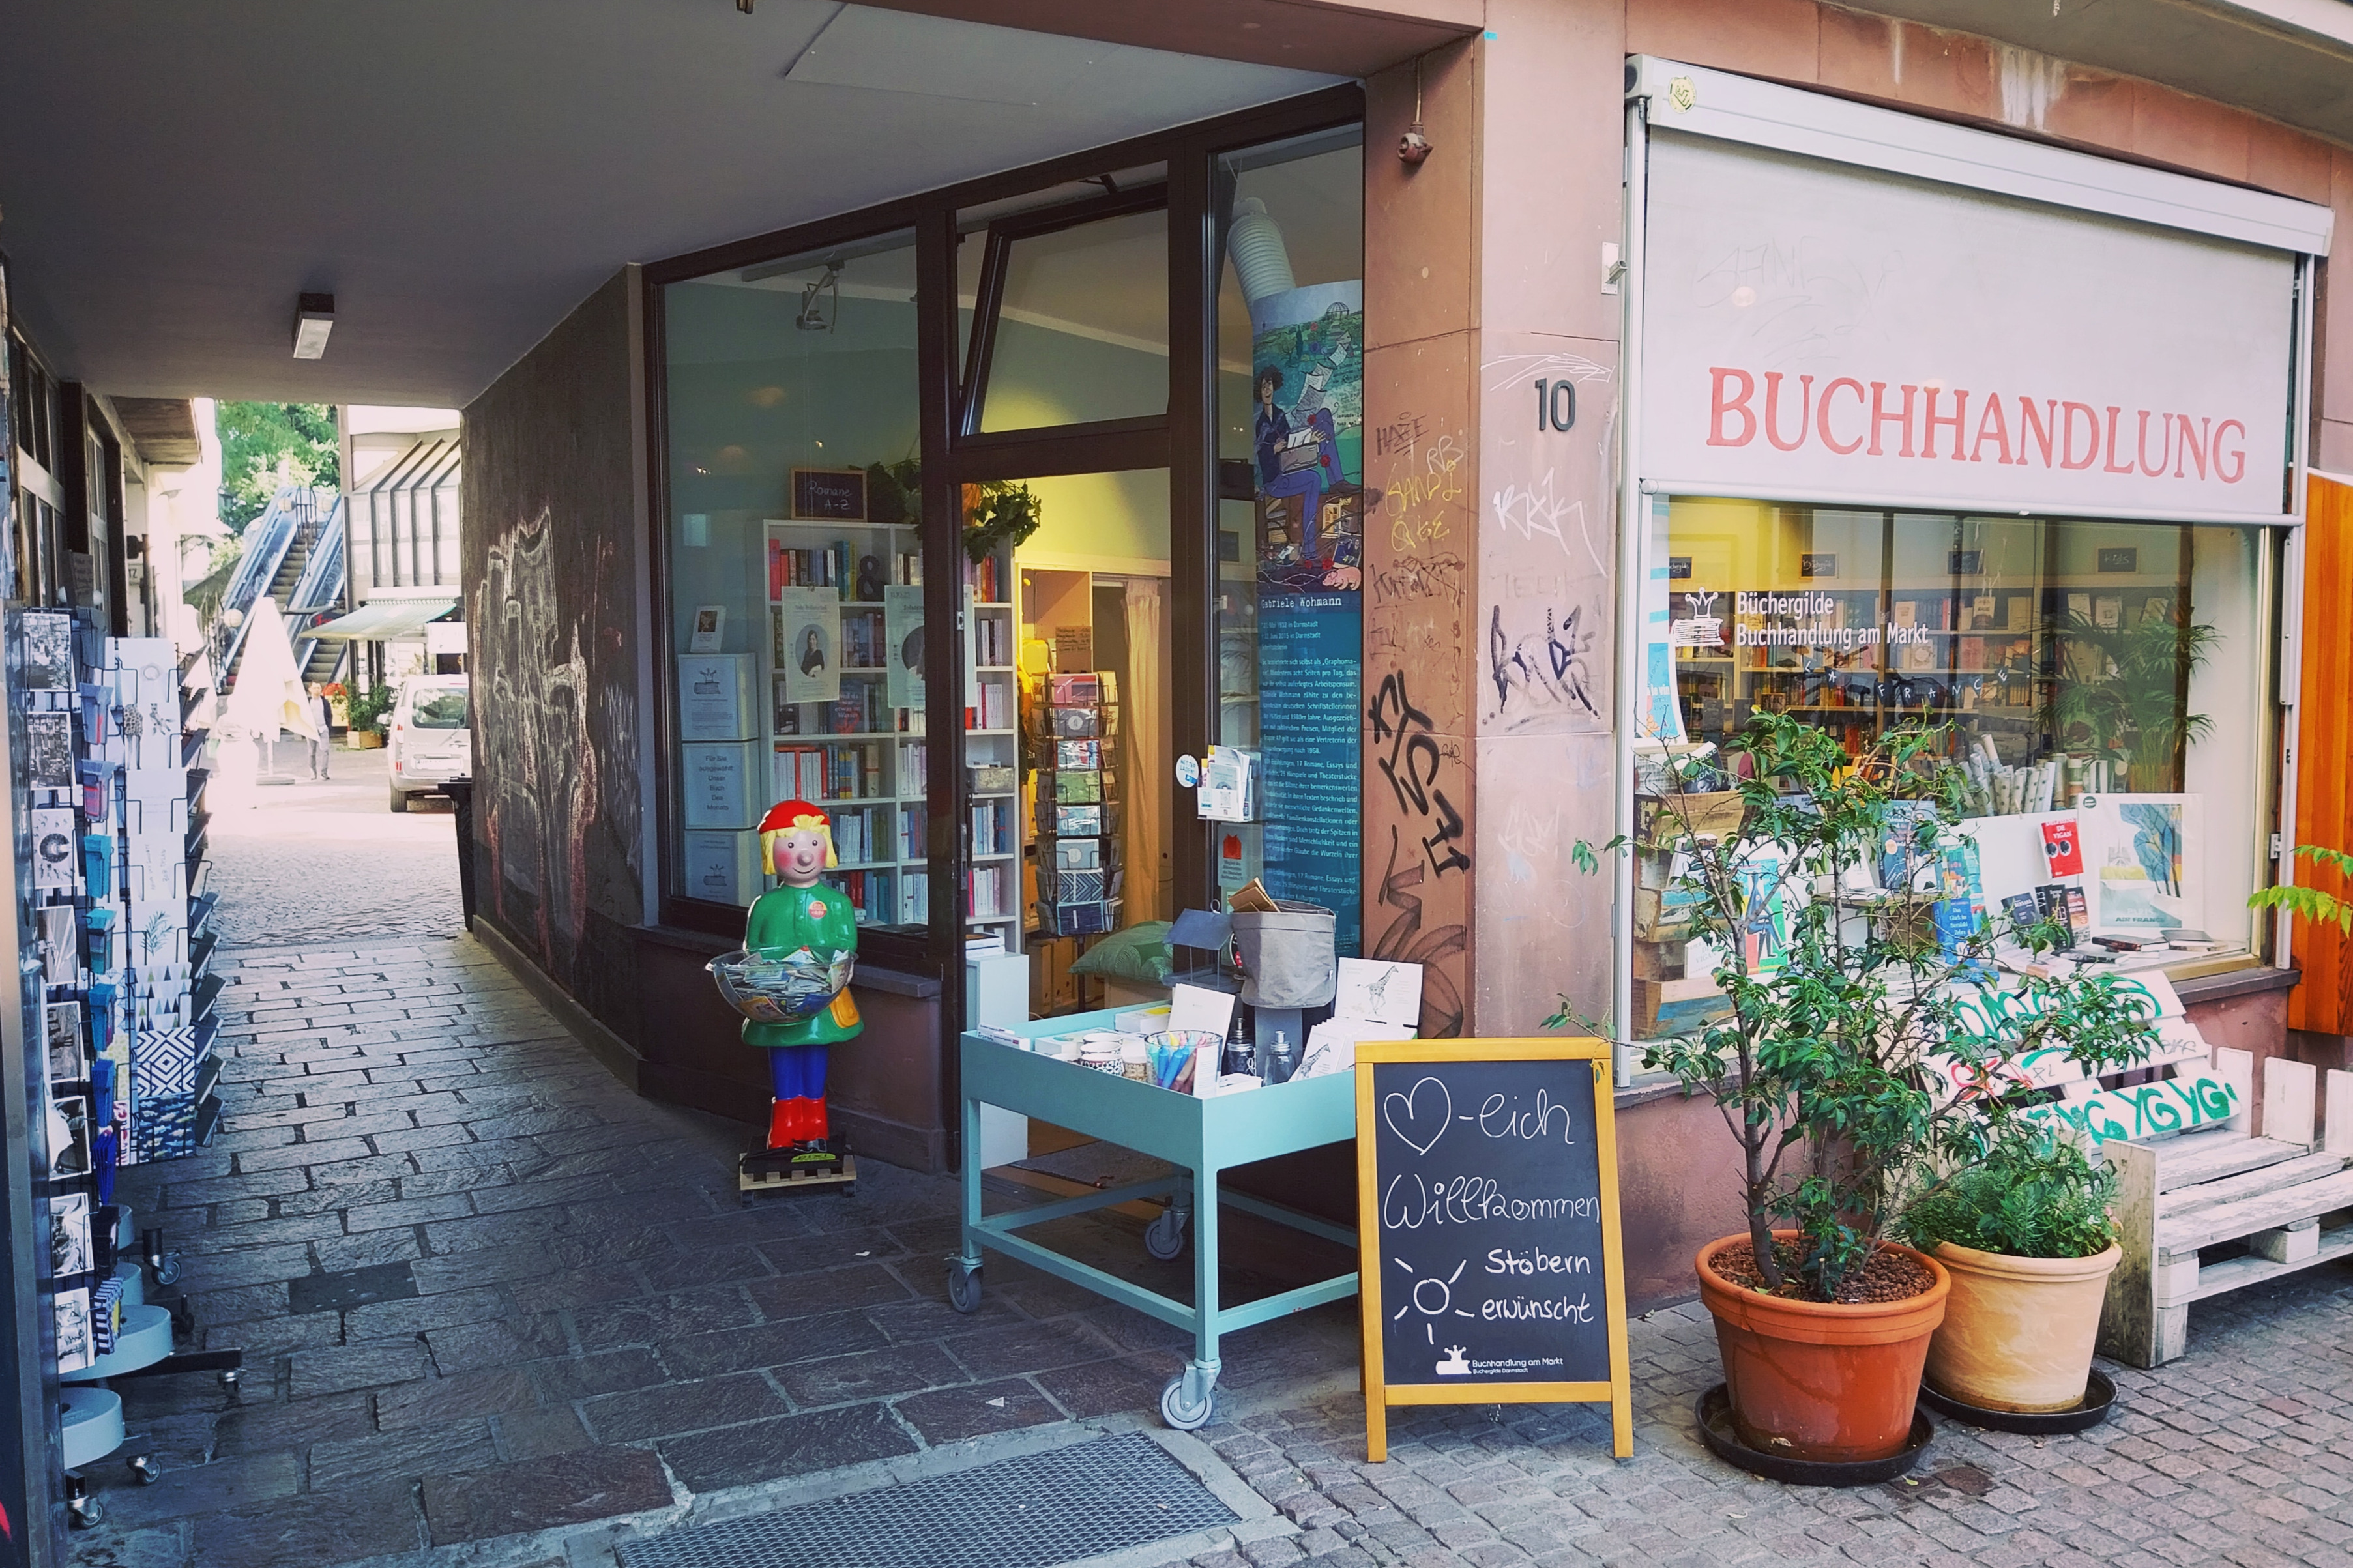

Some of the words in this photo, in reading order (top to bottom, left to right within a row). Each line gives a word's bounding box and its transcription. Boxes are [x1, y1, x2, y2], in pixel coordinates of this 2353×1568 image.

[1535, 377, 1576, 431] 10
[1706, 366, 2247, 485] BUCHHANDLUNG
[810, 480, 853, 497] Romane
[1261, 598, 1294, 609] Gabriele
[1300, 596, 1342, 607] Wohmann
[1737, 591, 1834, 620] Büchergilde
[1736, 622, 1852, 650] Buchhandlung
[1858, 627, 1881, 645] am
[1887, 621, 1929, 644] Markt
[1333, 669, 1344, 678] Tag,
[1323, 714, 1357, 723] Ausgezeich-
[1322, 725, 1345, 734] Mitglied
[1326, 761, 1343, 770] Essays
[1319, 772, 1357, 780] Theaterstücke
[1310, 783, 1357, 791] bemerkenswerten
[1312, 805, 1358, 814] Gedankenwelten,
[1286, 813, 1343, 824] Familienkonstellationen
[1330, 828, 1351, 837] Spitzen
[2053, 830, 2073, 839] VIGAN
[1298, 837, 1335, 846] Menschlichkeit
[1321, 849, 1342, 858] Wurzeln
[1326, 875, 1343, 884] Essays
[1319, 885, 1356, 895] Theaterstücke
[1384, 1174, 1601, 1230] Willkommen
[1485, 1246, 1592, 1275] Stöbern
[1481, 1293, 1595, 1324] erwünscht
[1472, 1359, 1527, 1369] Buchhandlung
[1542, 1357, 1564, 1366] Markt
